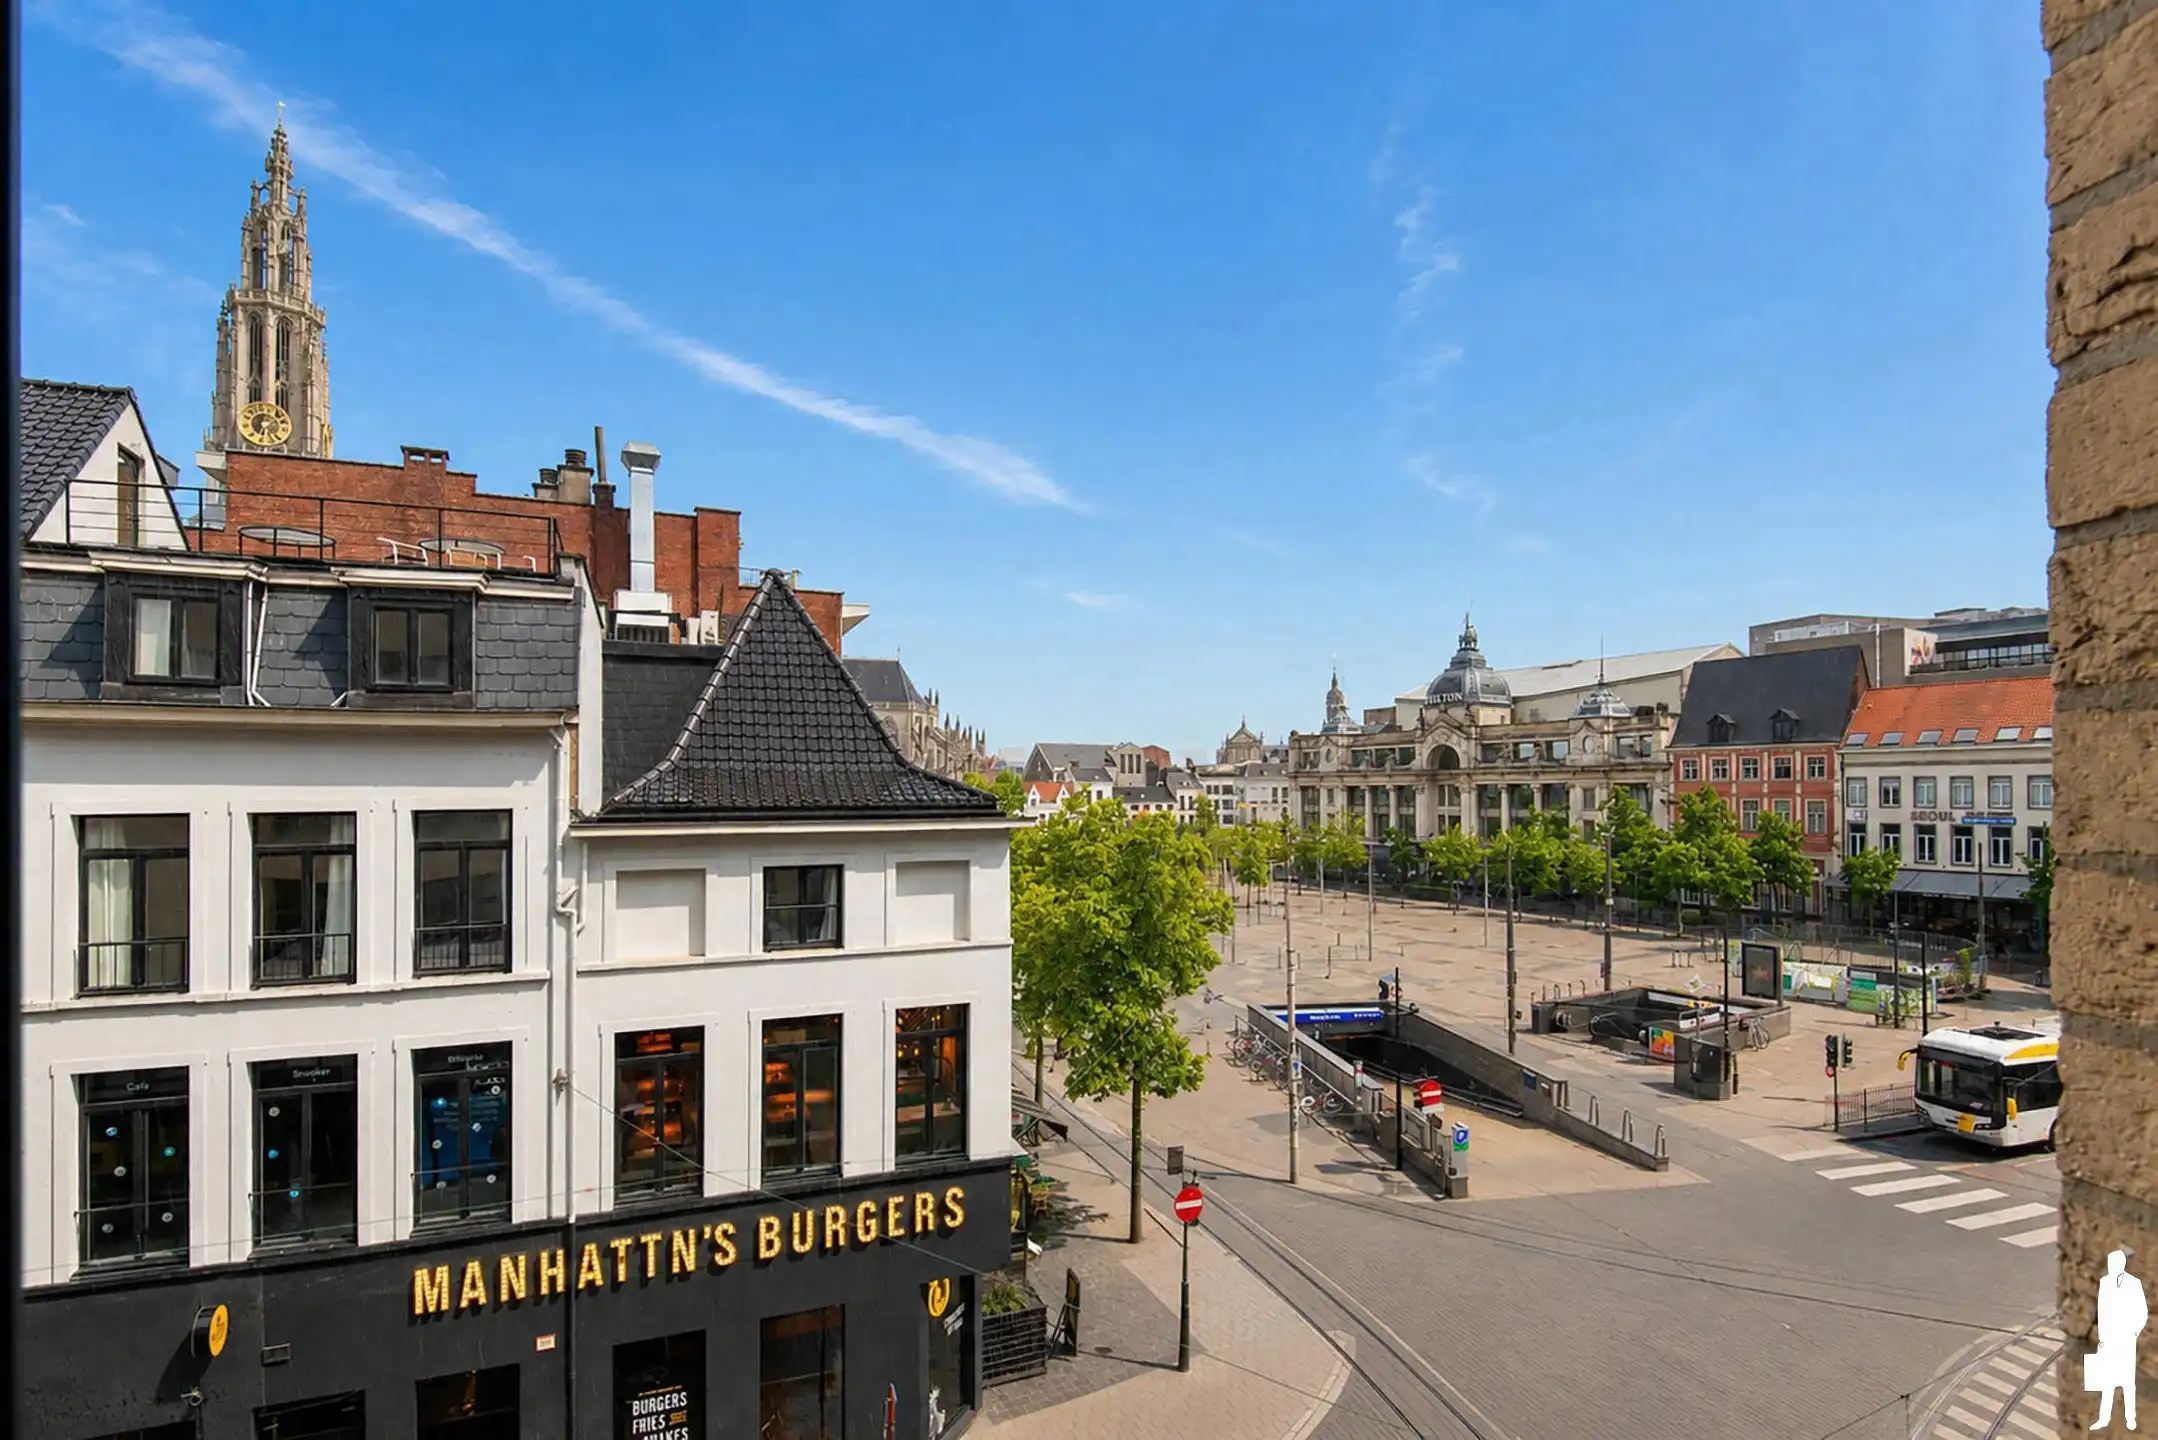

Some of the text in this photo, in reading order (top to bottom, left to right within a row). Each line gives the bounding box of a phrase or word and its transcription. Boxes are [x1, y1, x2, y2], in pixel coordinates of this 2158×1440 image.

[1424, 692, 1463, 705] HILTON
[413, 1185, 966, 1315] MANHATTN'S BURGERS
[632, 1391, 688, 1416] BURGERS
[632, 1414, 666, 1434] FRIES
